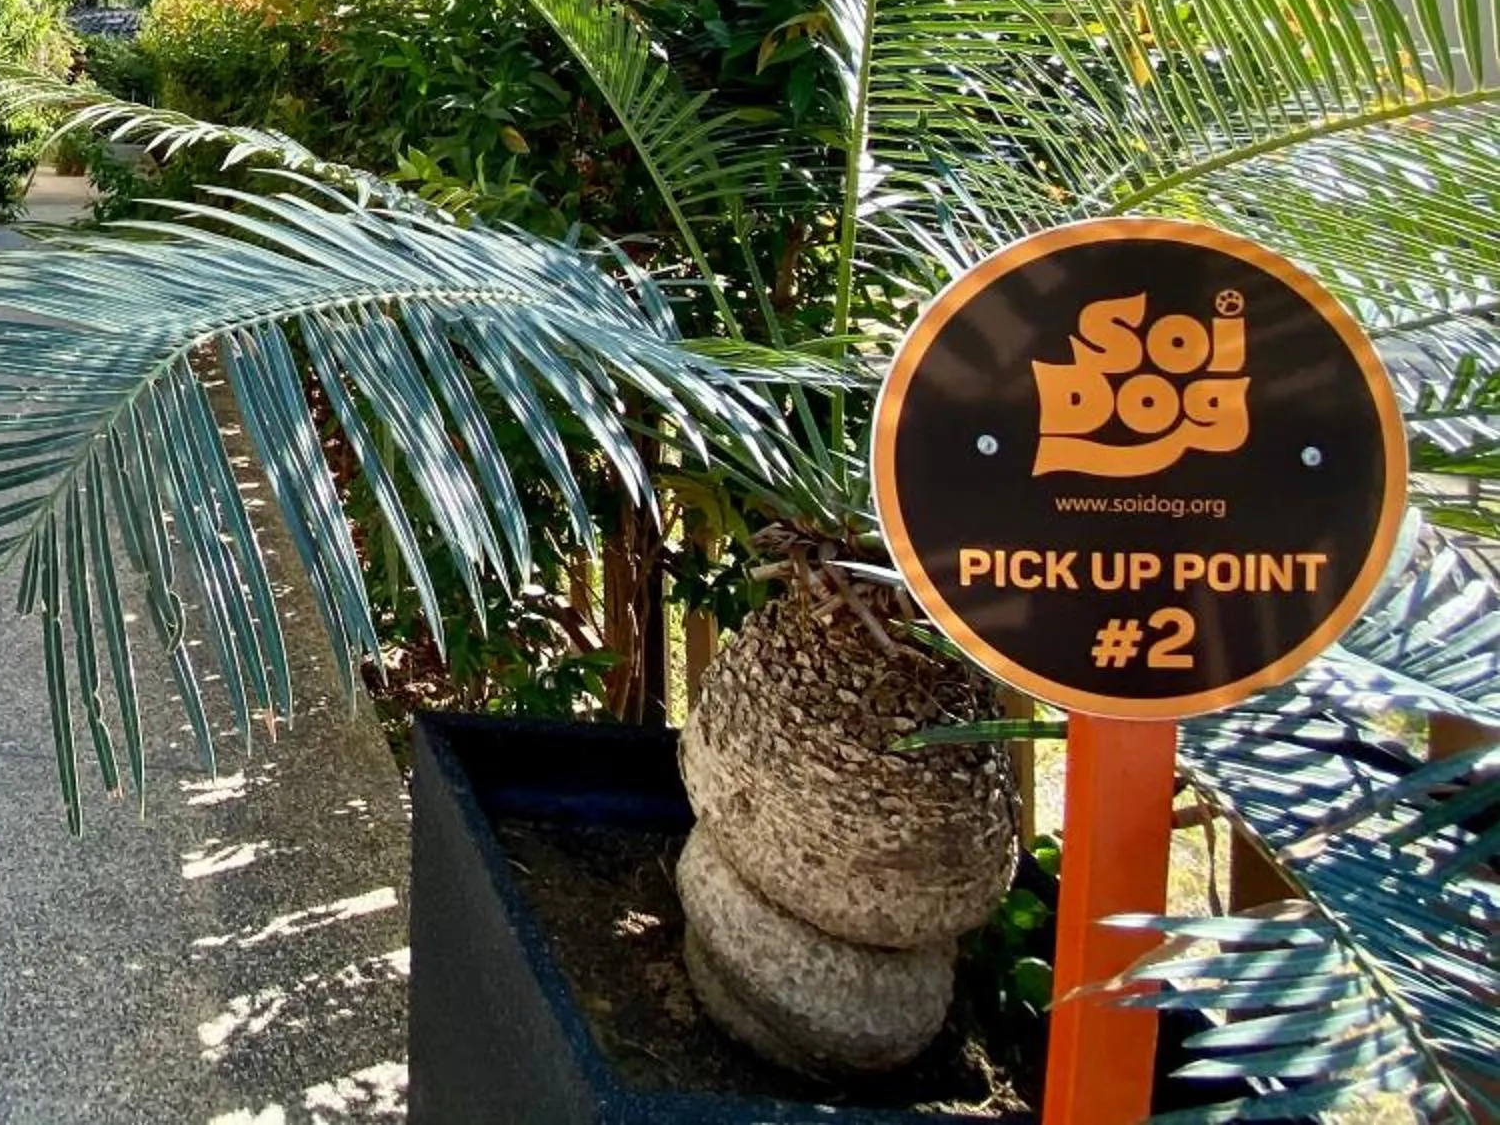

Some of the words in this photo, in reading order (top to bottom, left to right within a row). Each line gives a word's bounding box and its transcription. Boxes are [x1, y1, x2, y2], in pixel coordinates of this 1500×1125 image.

[1073, 288, 1247, 374] Soi
[1031, 359, 1252, 478] Dog
[1055, 494, 1227, 518] www.soidog.org
[958, 548, 1079, 590] PICK
[1091, 551, 1162, 591] UP
[1173, 553, 1328, 593] POINT
[1091, 606, 1197, 669] #2
